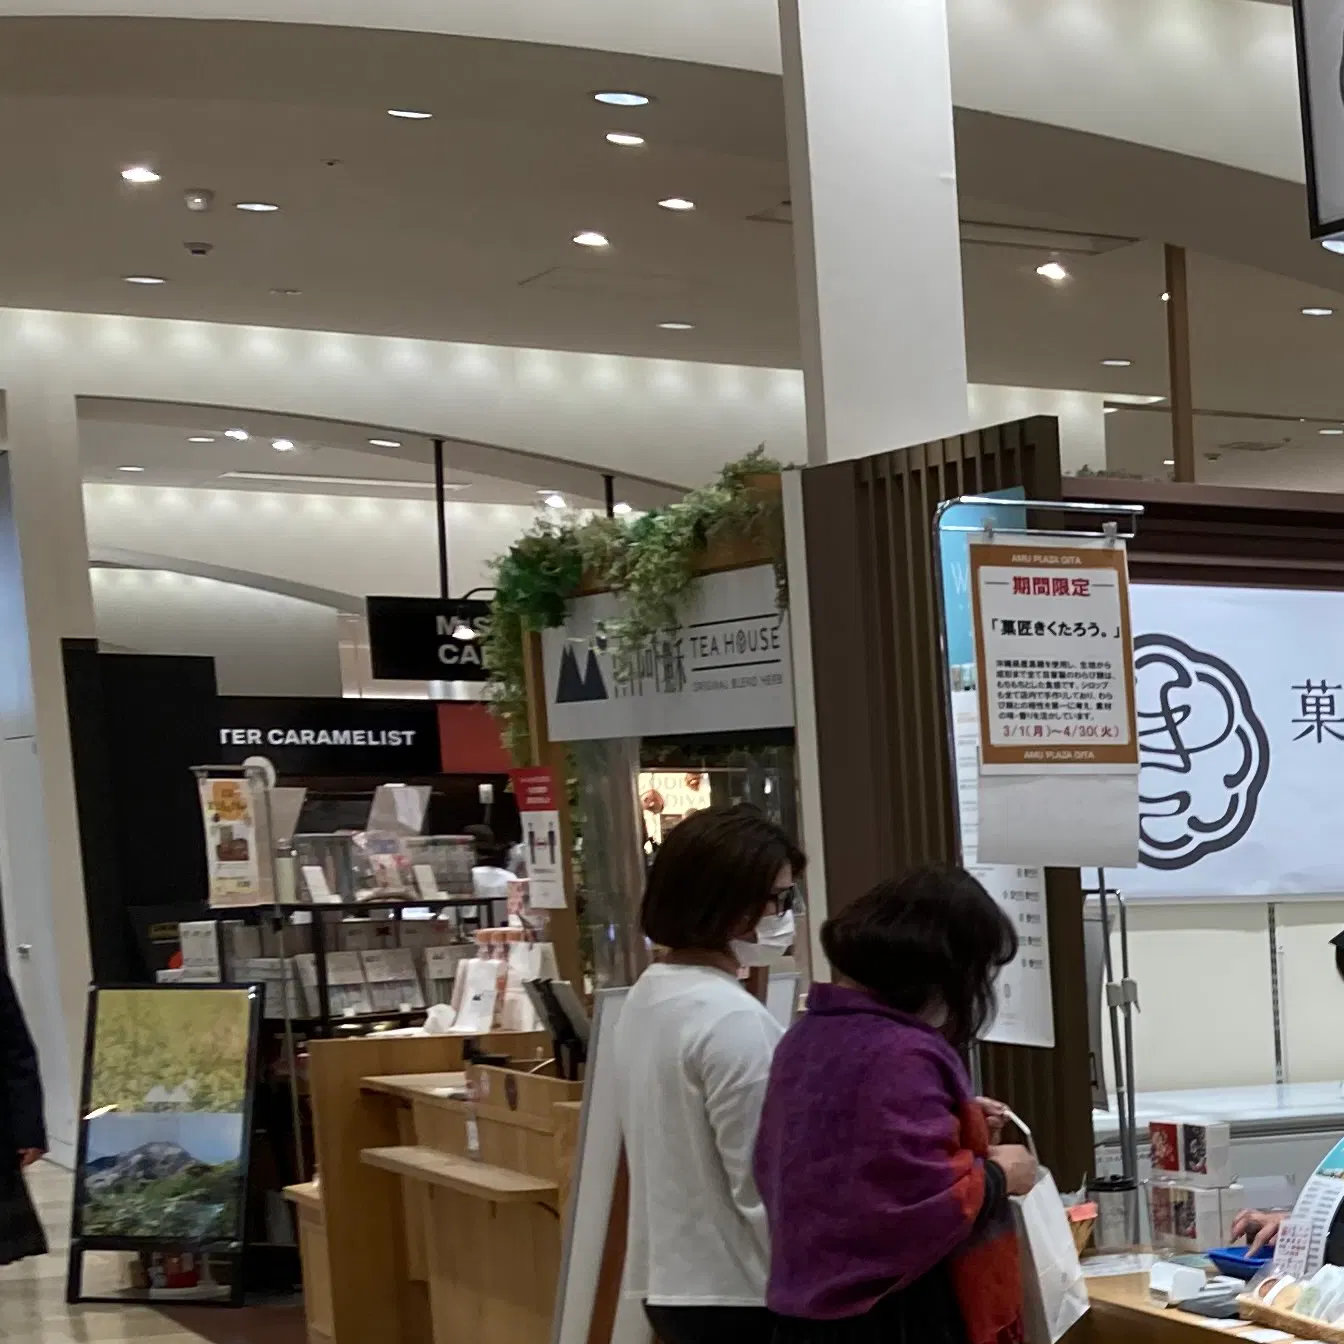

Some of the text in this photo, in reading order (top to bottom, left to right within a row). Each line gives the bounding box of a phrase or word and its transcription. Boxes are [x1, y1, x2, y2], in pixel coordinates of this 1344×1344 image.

[1012, 575, 1091, 597] 期間限定
[690, 626, 780, 659] TEA HOUSE
[267, 729, 416, 747] CARAMELIST
